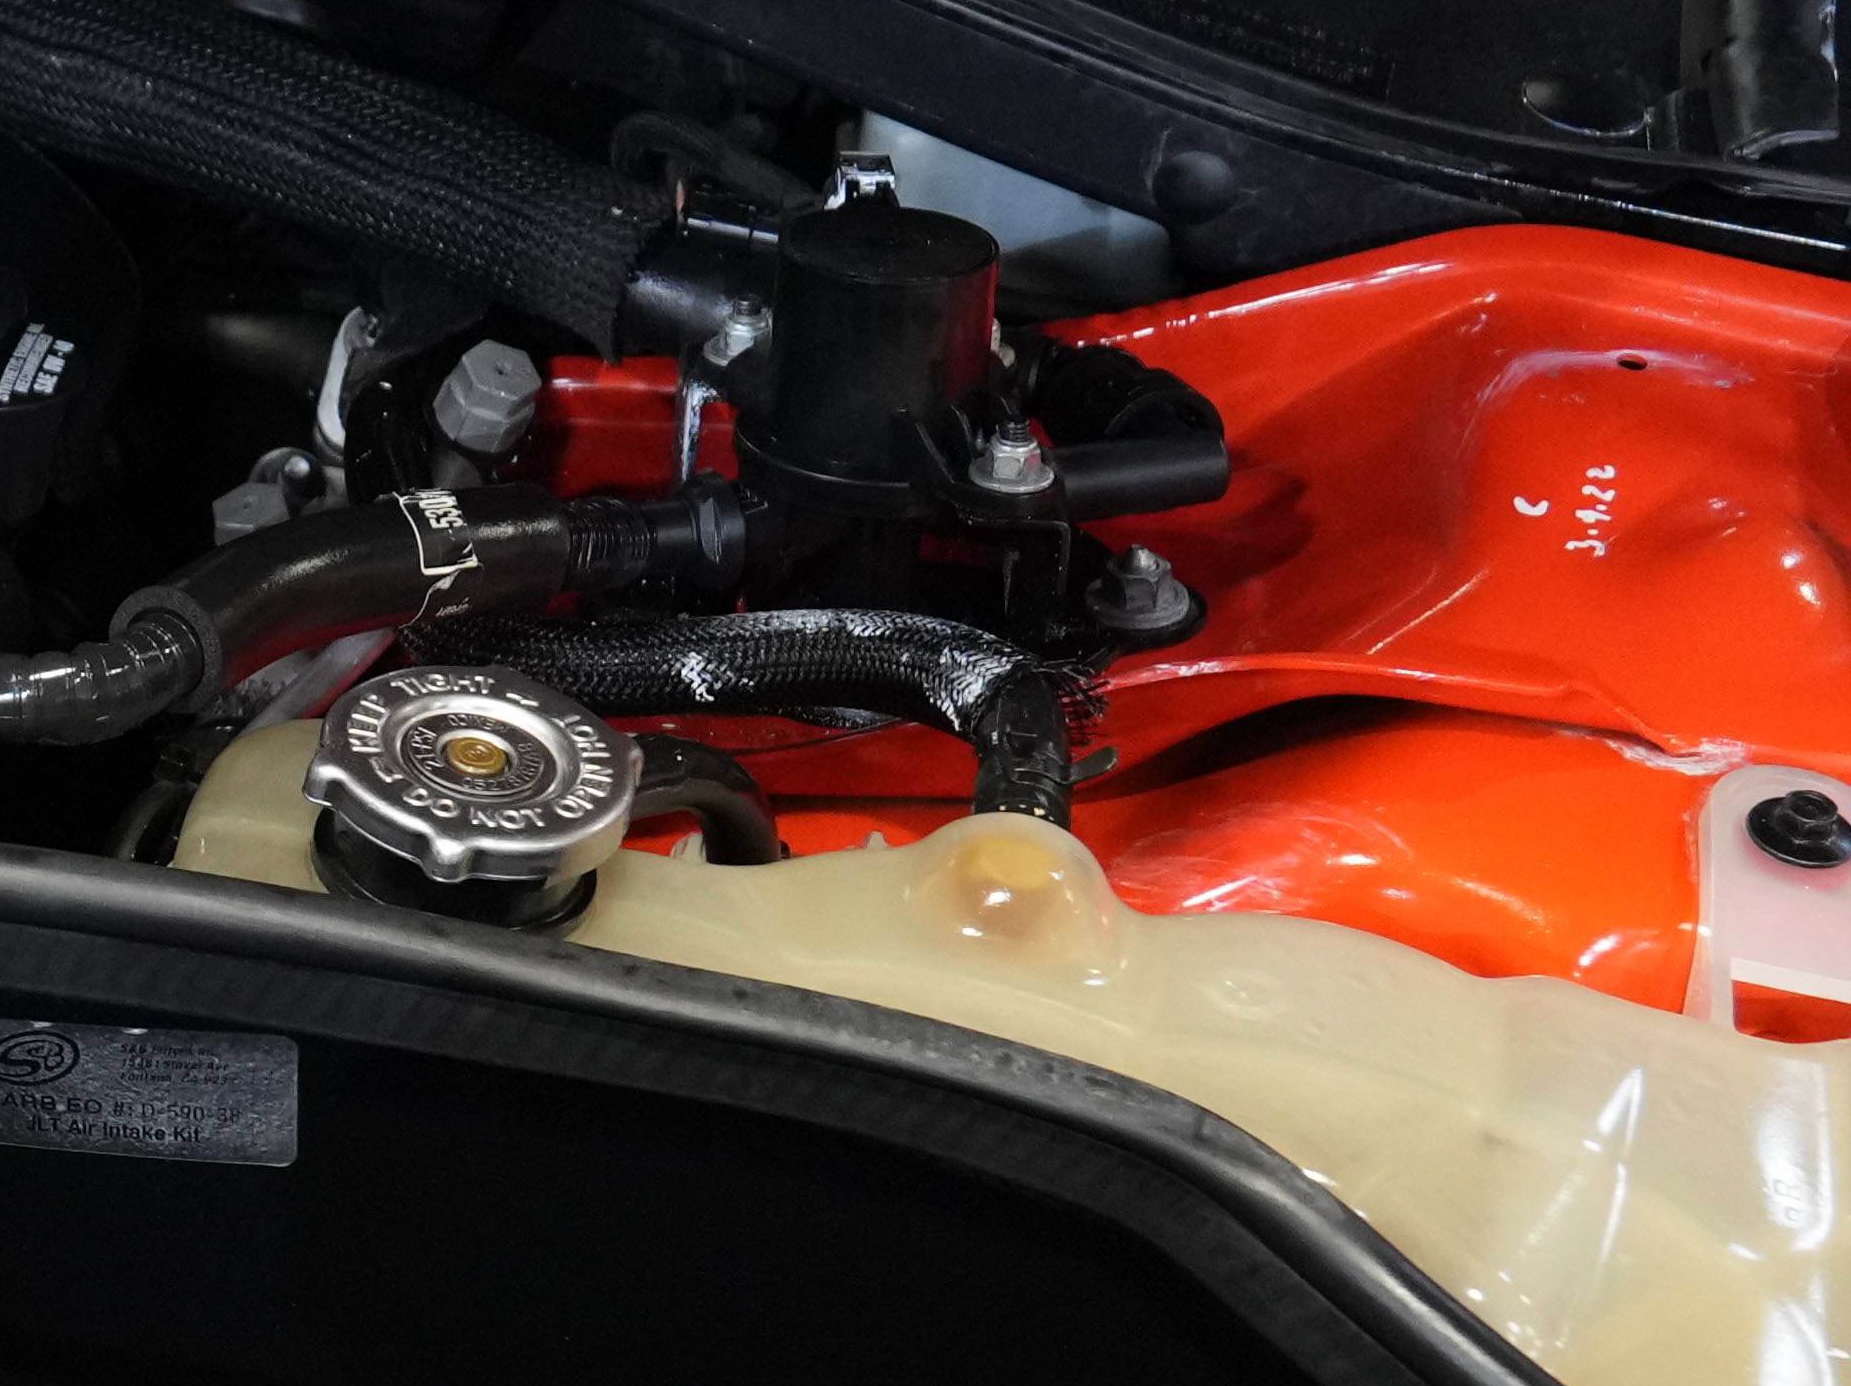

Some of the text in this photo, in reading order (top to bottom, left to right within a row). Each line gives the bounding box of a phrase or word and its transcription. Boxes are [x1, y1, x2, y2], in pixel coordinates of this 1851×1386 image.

[347, 673, 496, 754] KEEP TIGHT
[550, 714, 613, 759] HOT
[554, 763, 614, 819] OPEN
[470, 807, 546, 830] NOT
[67, 1098, 102, 1114] EO
[26, 1116, 202, 1143] JLT Air Intake Kit
